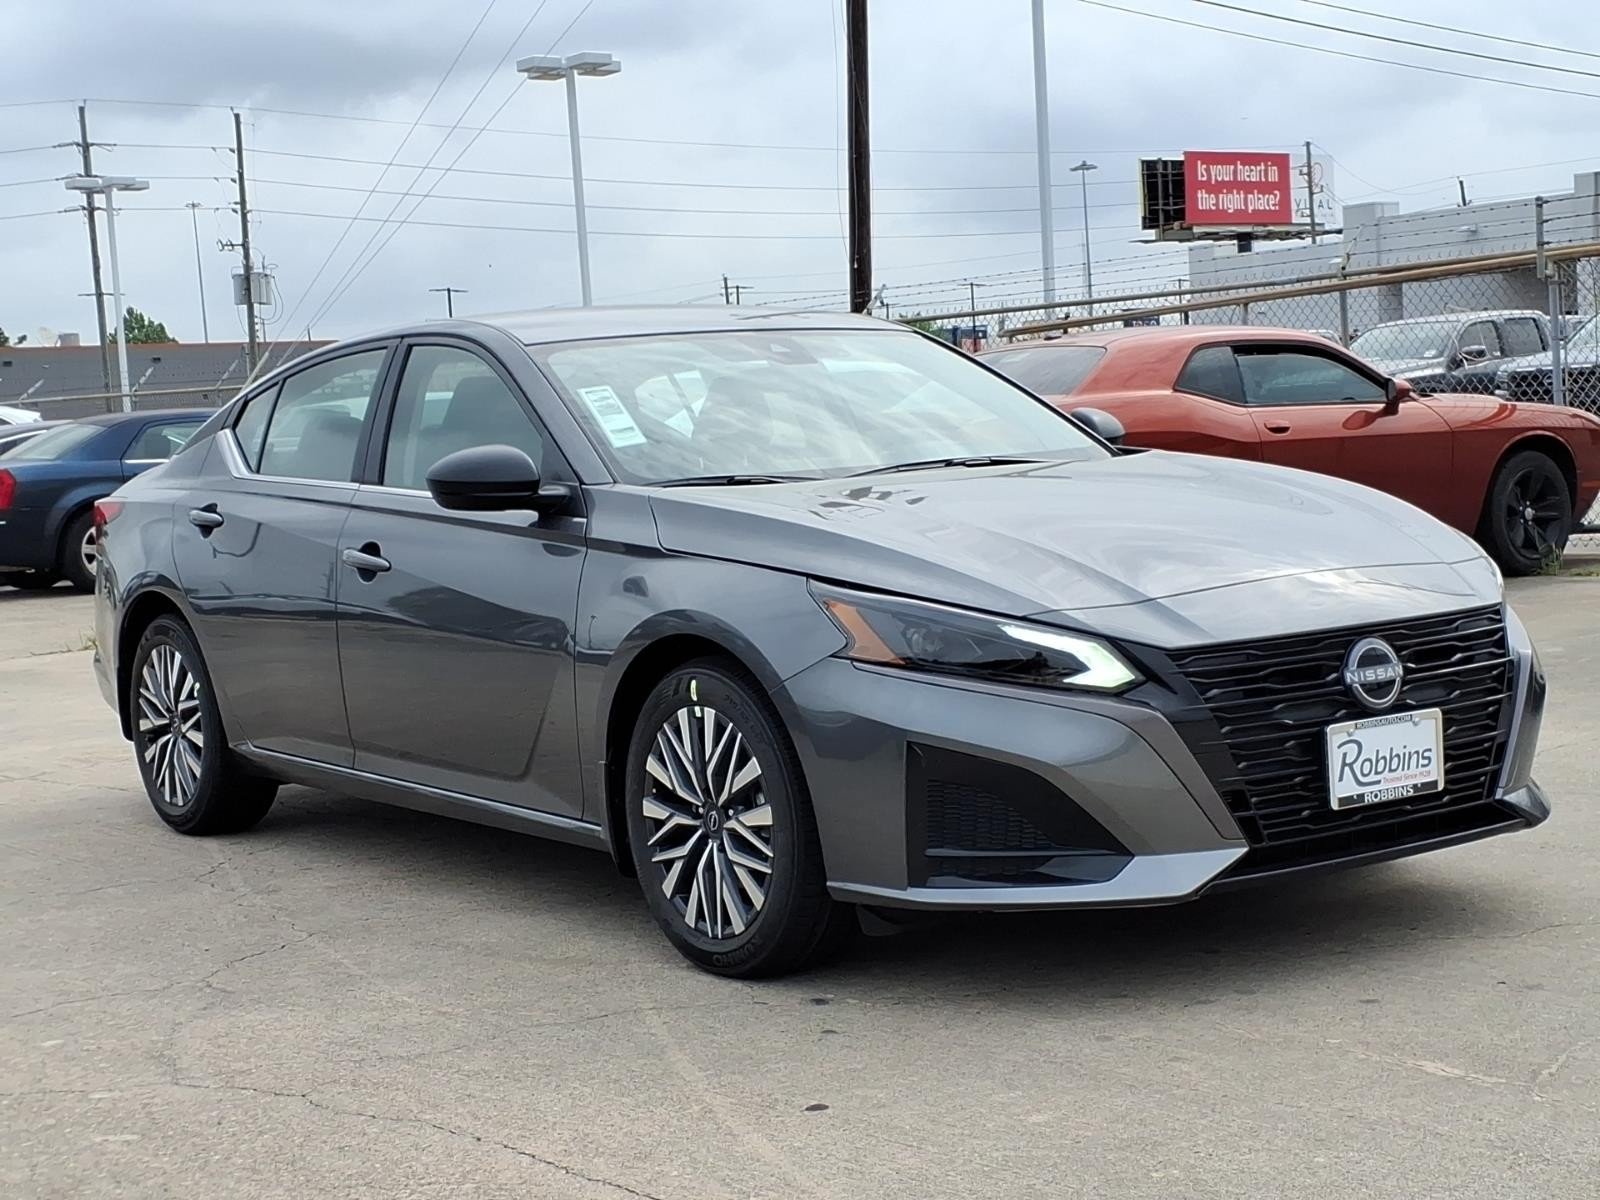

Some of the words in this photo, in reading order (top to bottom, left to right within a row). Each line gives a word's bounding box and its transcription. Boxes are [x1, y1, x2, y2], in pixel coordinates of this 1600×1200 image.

[1197, 160, 1207, 181] Is
[1210, 164, 1235, 184] your
[1237, 161, 1265, 182] heart
[1268, 162, 1279, 182] in
[1197, 189, 1216, 210] the
[1219, 189, 1245, 213] right
[1247, 190, 1280, 213] place?
[1294, 198, 1333, 210] VIAL
[1346, 666, 1403, 683] NISSAN
[1337, 739, 1432, 787] Robbins
[1364, 784, 1414, 804] ROBBINS
